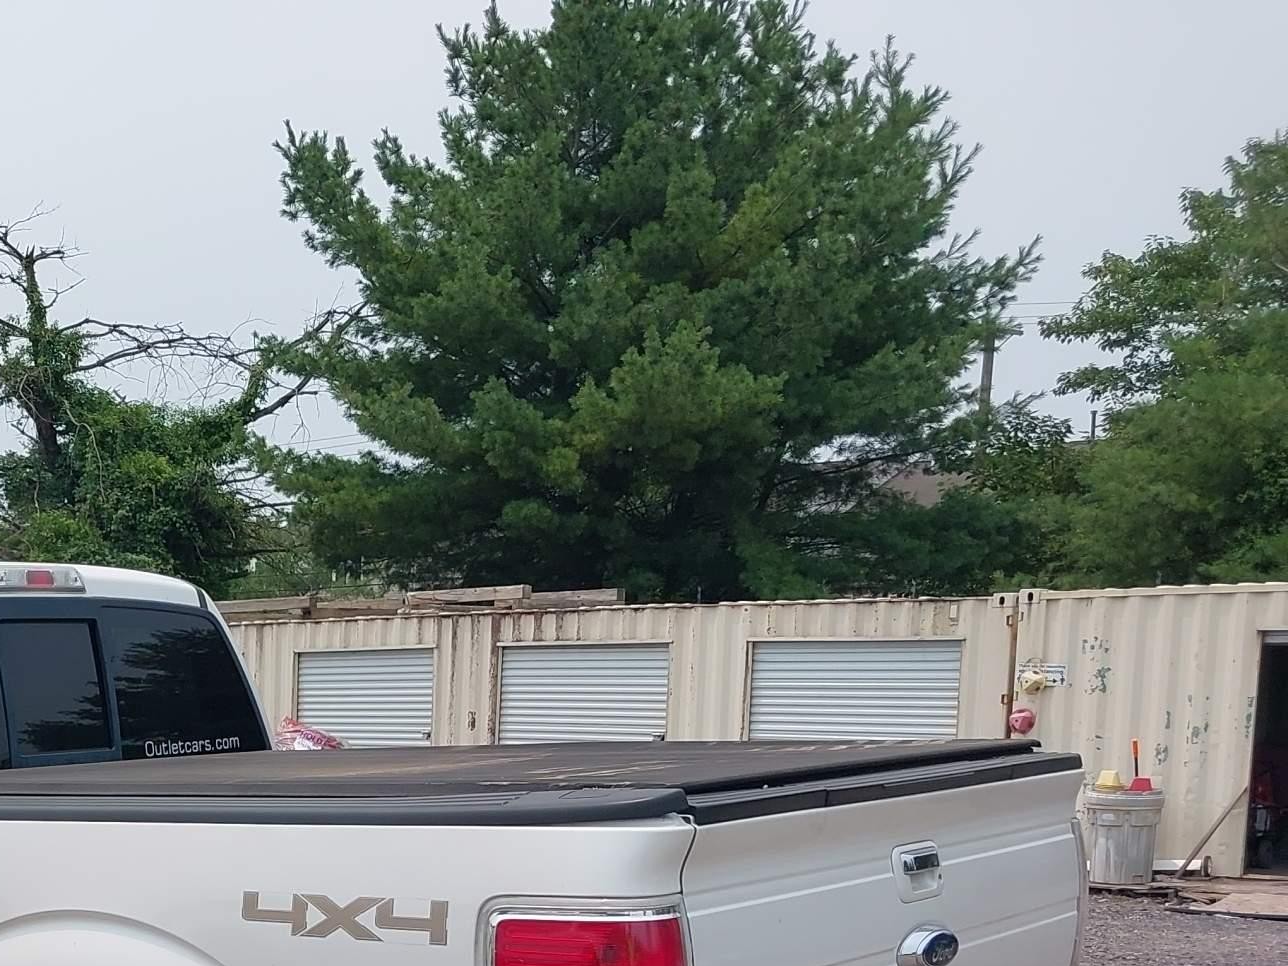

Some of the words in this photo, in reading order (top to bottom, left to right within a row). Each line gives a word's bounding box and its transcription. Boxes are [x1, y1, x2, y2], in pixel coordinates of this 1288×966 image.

[144, 736, 241, 758] Outletcars.com
[241, 890, 449, 946] 4X4
[926, 940, 953, 963] Ford
